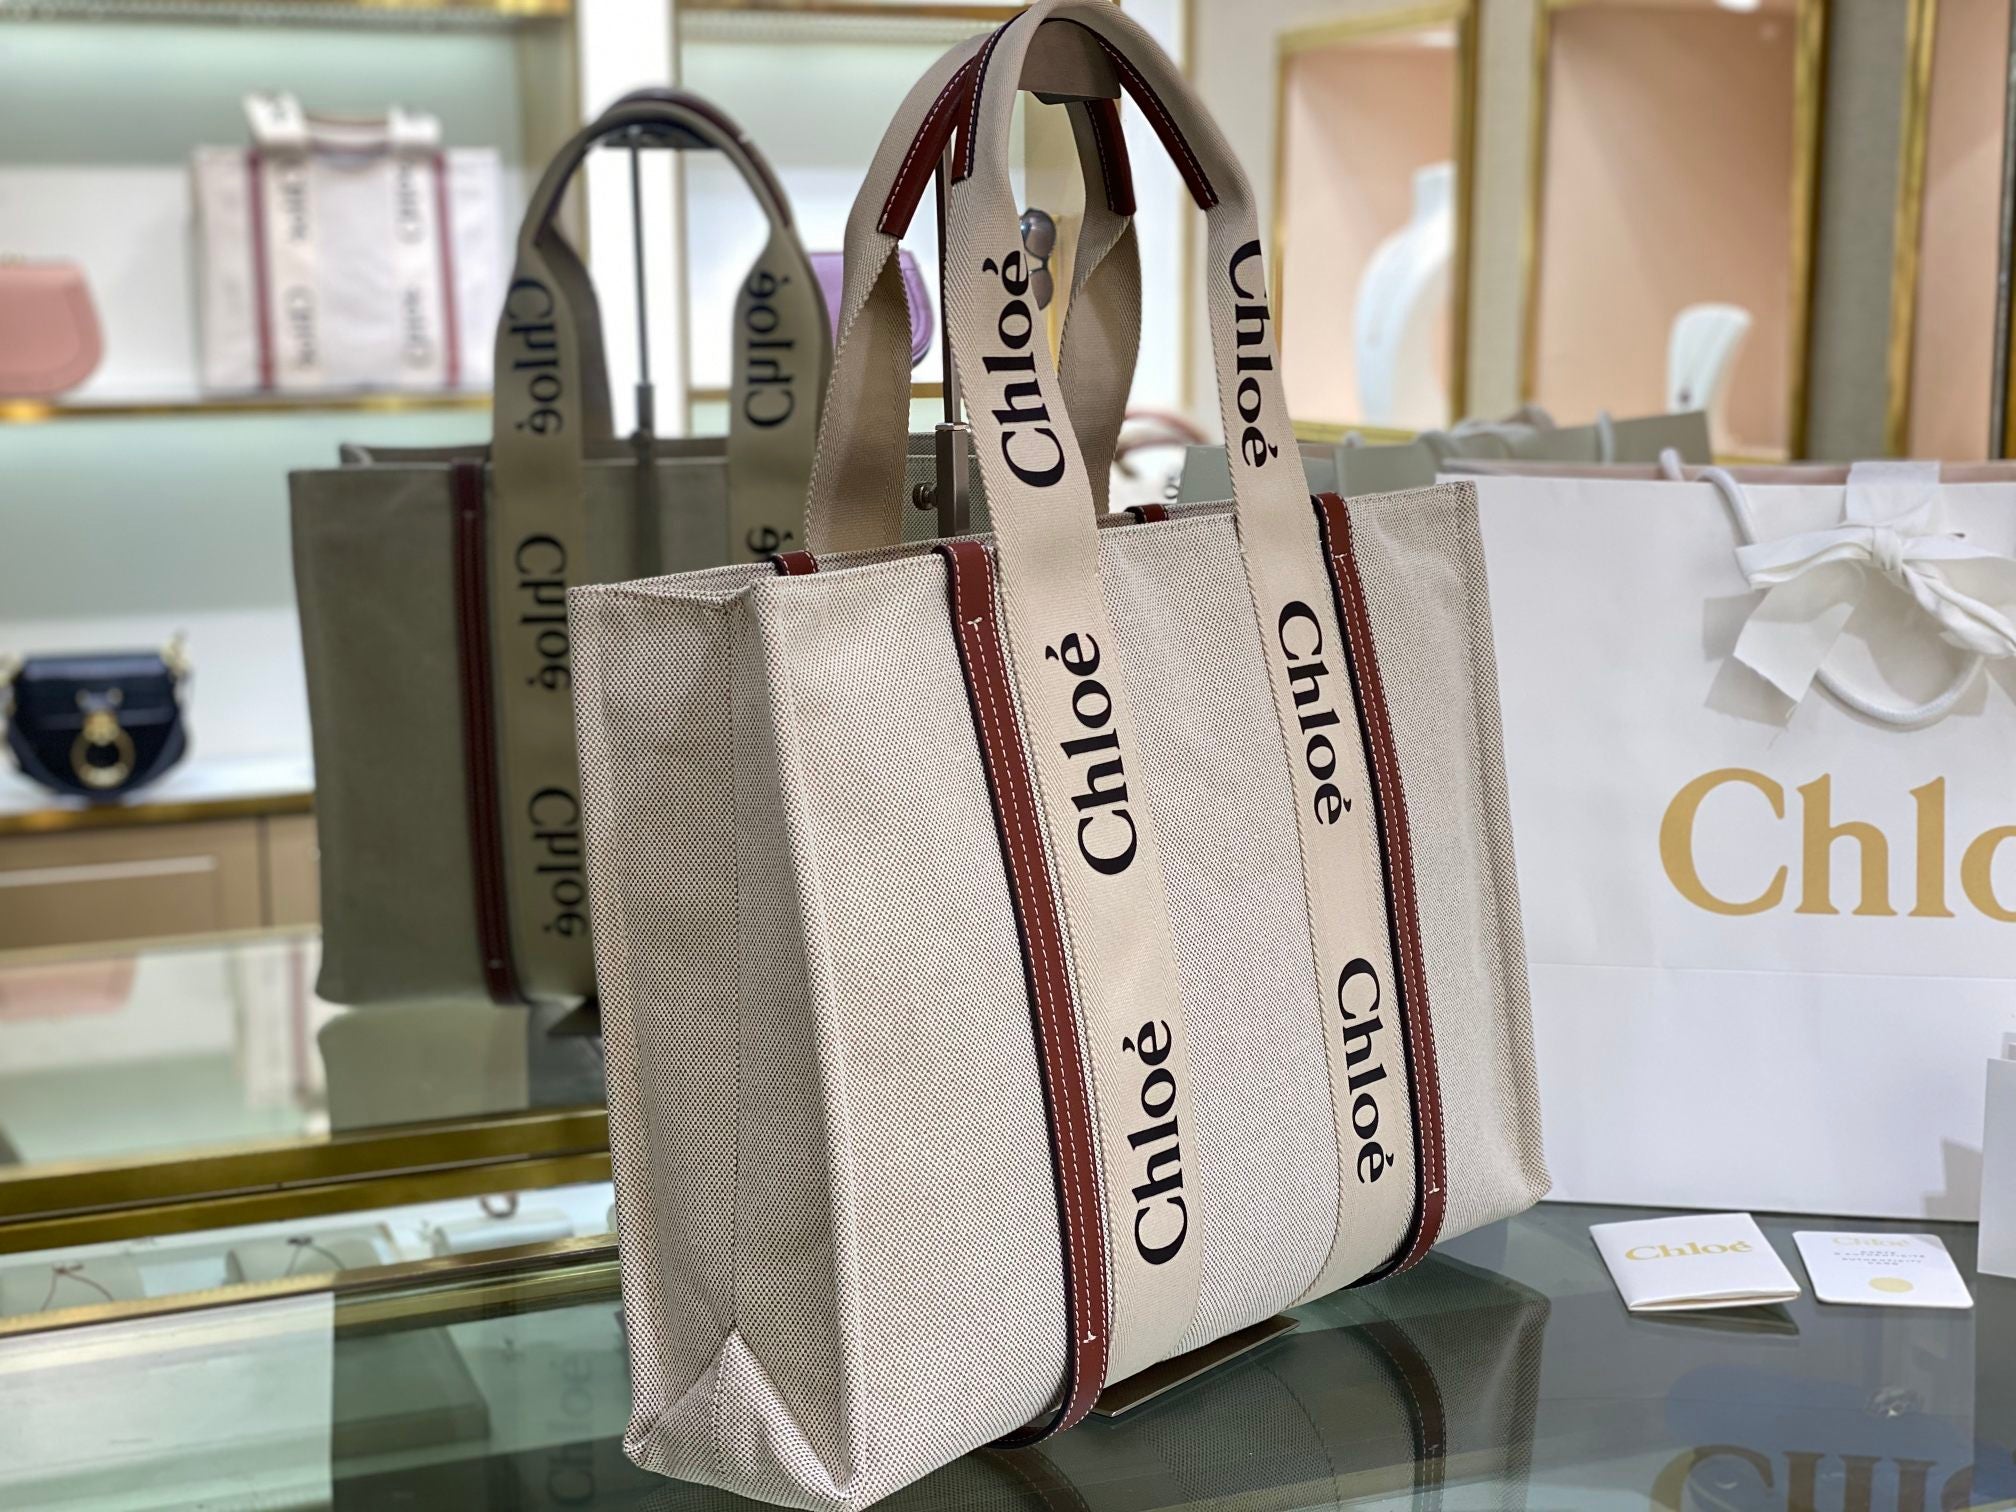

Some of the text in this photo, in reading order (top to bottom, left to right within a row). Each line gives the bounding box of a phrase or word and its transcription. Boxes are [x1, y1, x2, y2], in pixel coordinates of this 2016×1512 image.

[982, 250, 1065, 487] Chloé
[1228, 239, 1278, 468] Chloé
[1045, 632, 1137, 875] Chloé
[1278, 600, 1351, 825] Chloé
[1123, 1020, 1188, 1265] Chloé
[1337, 957, 1394, 1184] Chloé
[1625, 1240, 1752, 1260] Chloé
